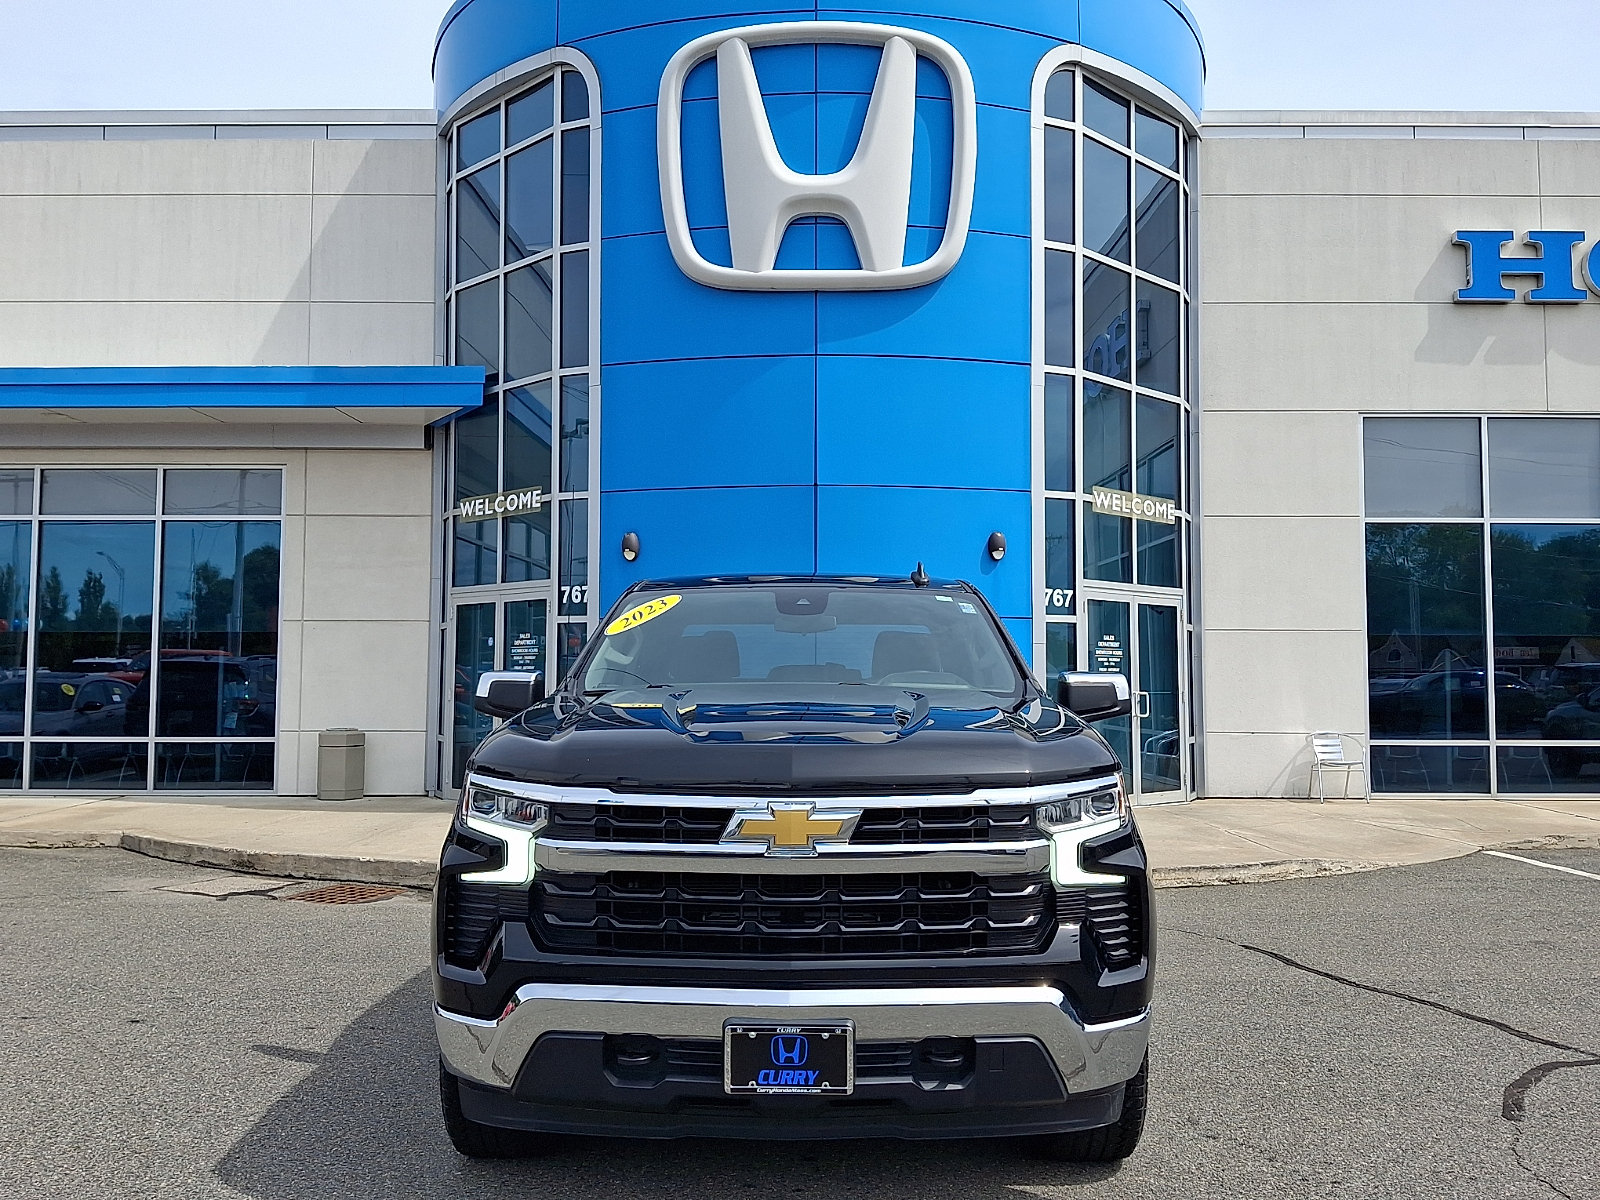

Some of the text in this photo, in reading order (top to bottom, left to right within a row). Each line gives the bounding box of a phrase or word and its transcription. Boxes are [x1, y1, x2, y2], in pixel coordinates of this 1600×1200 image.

[1451, 229, 1600, 303] H
[460, 489, 542, 518] WELCOME
[1093, 490, 1175, 521] WELCOME
[561, 585, 589, 604] 767
[1045, 589, 1073, 607] 767
[619, 599, 668, 629] 2023
[758, 1069, 819, 1085] CURRY
